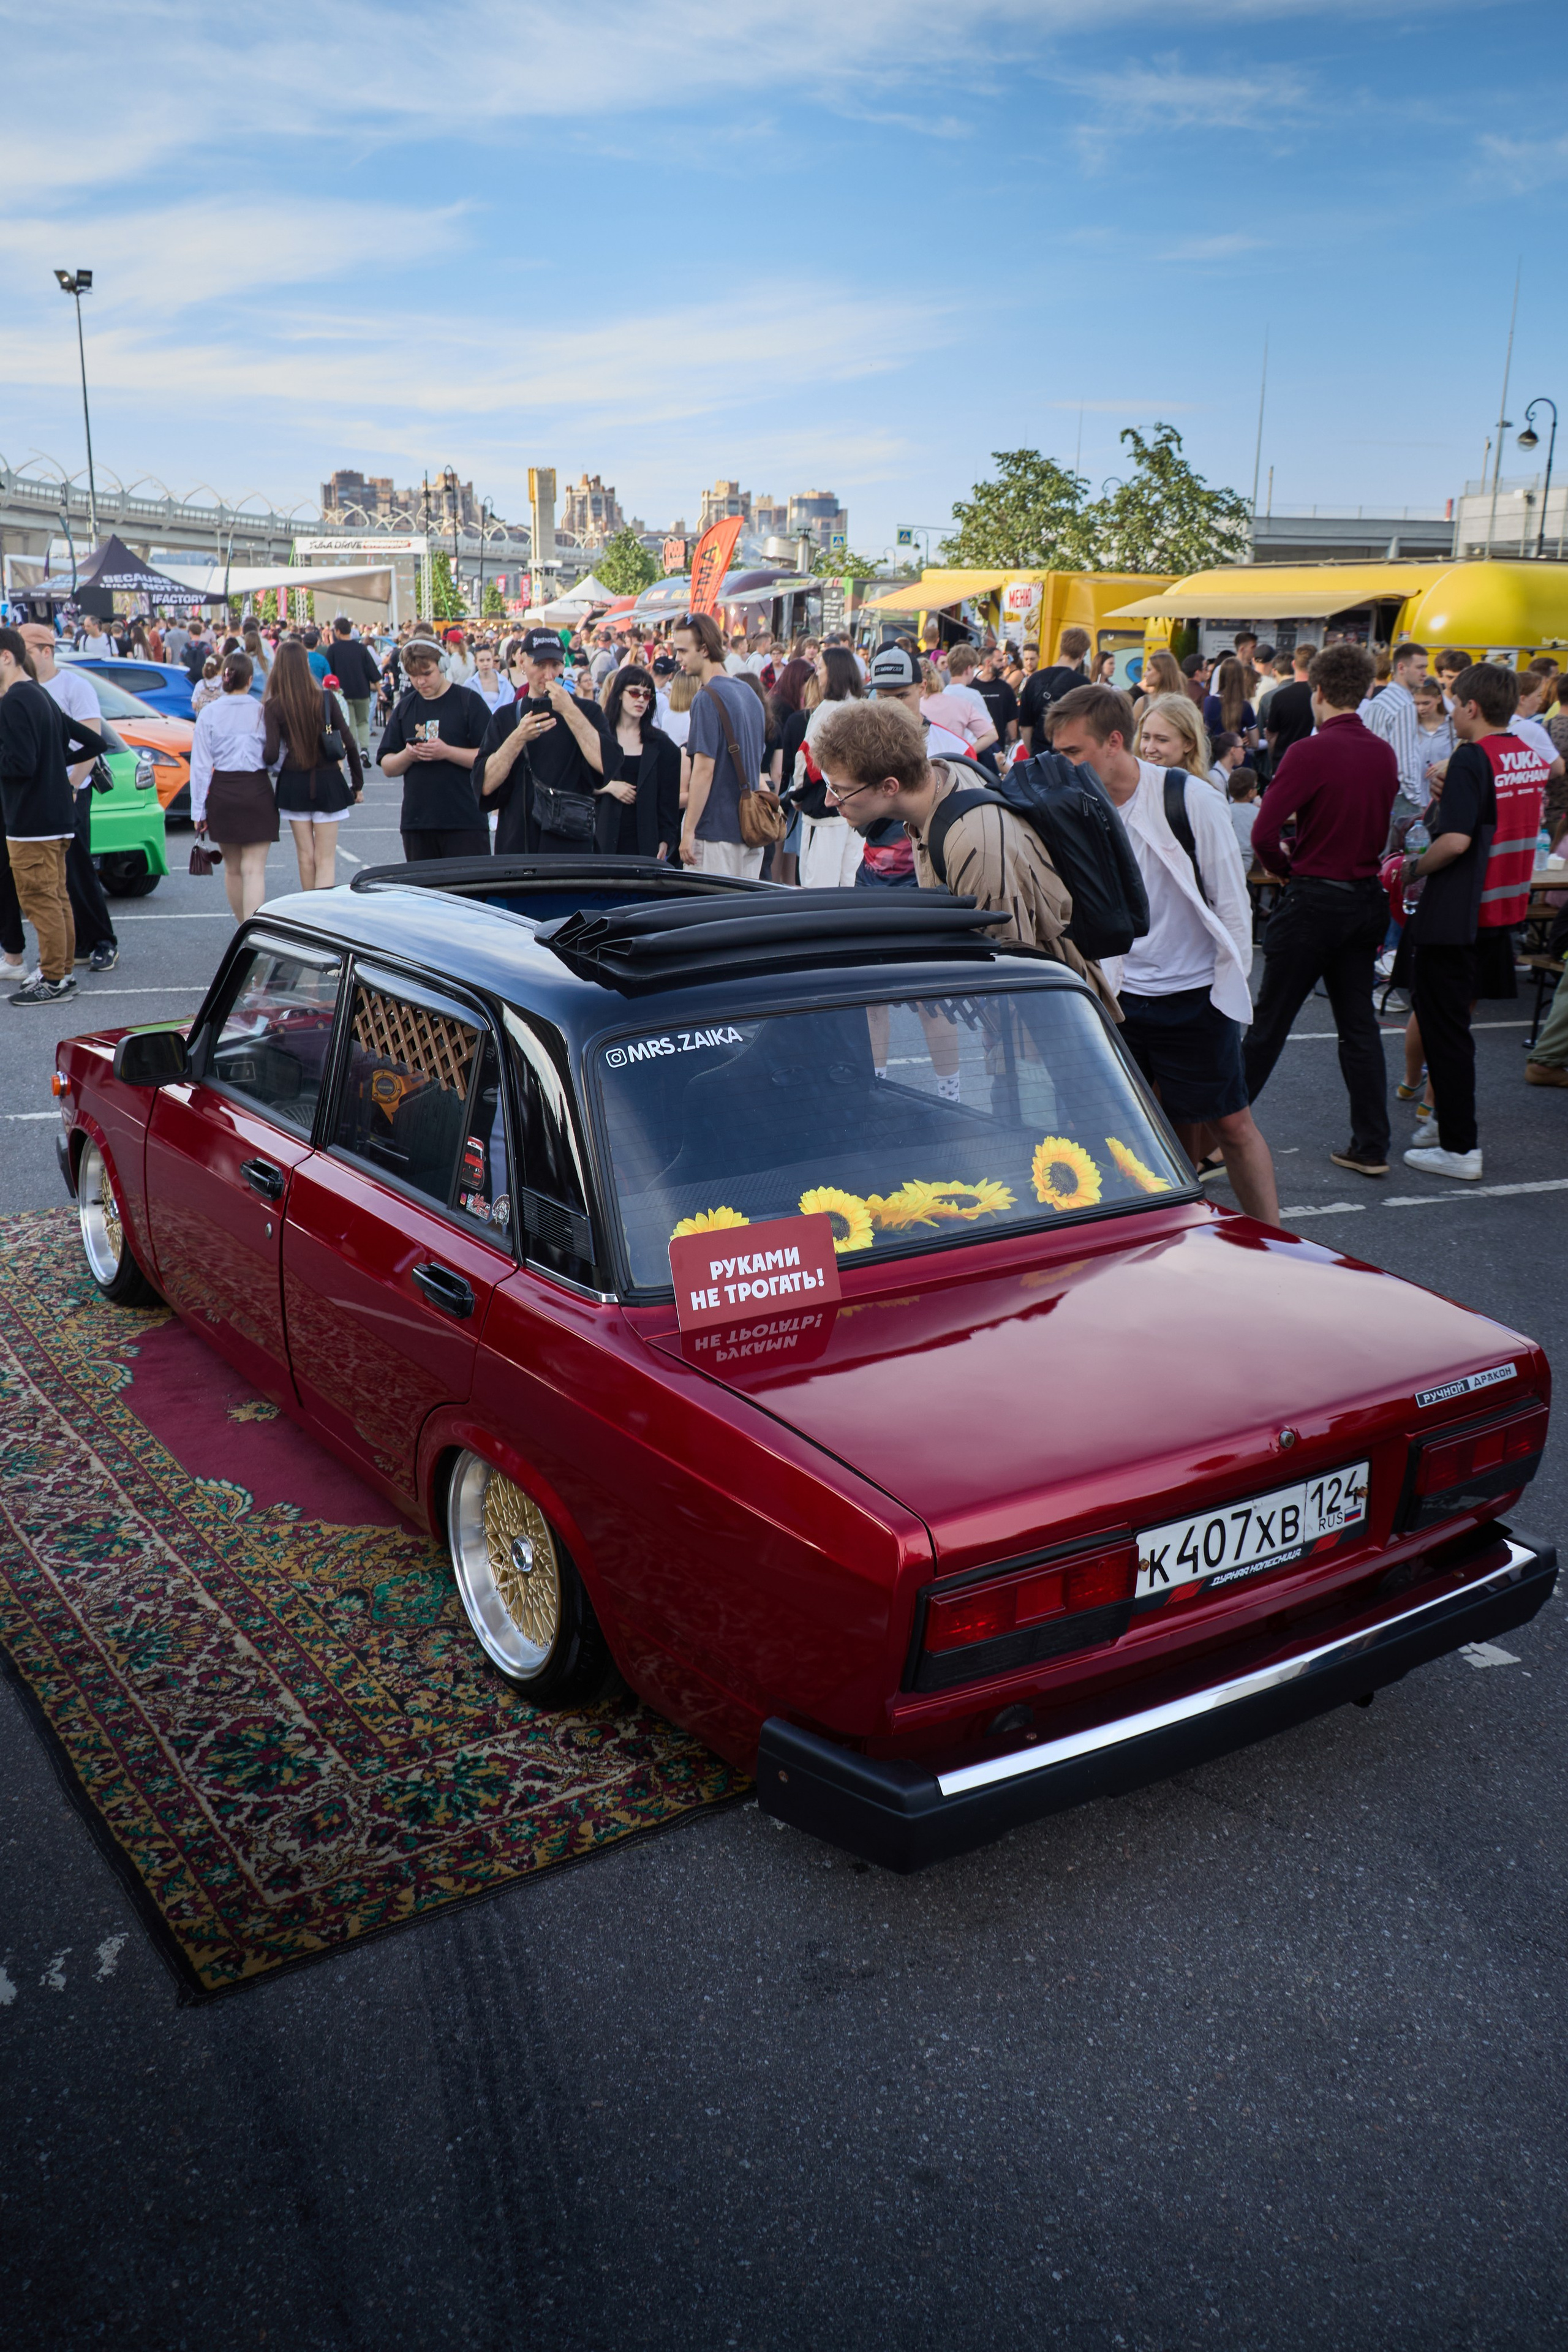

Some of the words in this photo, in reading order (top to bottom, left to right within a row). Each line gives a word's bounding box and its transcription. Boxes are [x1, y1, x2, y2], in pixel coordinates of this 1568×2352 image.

[102, 573, 172, 585] BECAUSE
[1009, 588, 1032, 609] МЕНЮ
[1498, 750, 1543, 772] YUKA
[1494, 768, 1550, 788] GYMKHAN
[627, 1027, 744, 1063] MRS.ZAIKA
[709, 1246, 801, 1281] РУКАМИ
[690, 1287, 721, 1311] НЕ
[724, 1268, 825, 1304] ТРОГАТЬ!
[1423, 1381, 1465, 1403] РУЧНОЙ
[1474, 1366, 1512, 1387] ДРАКОН
[1311, 1470, 1358, 1518] 124
[1319, 1511, 1343, 1532] RUS
